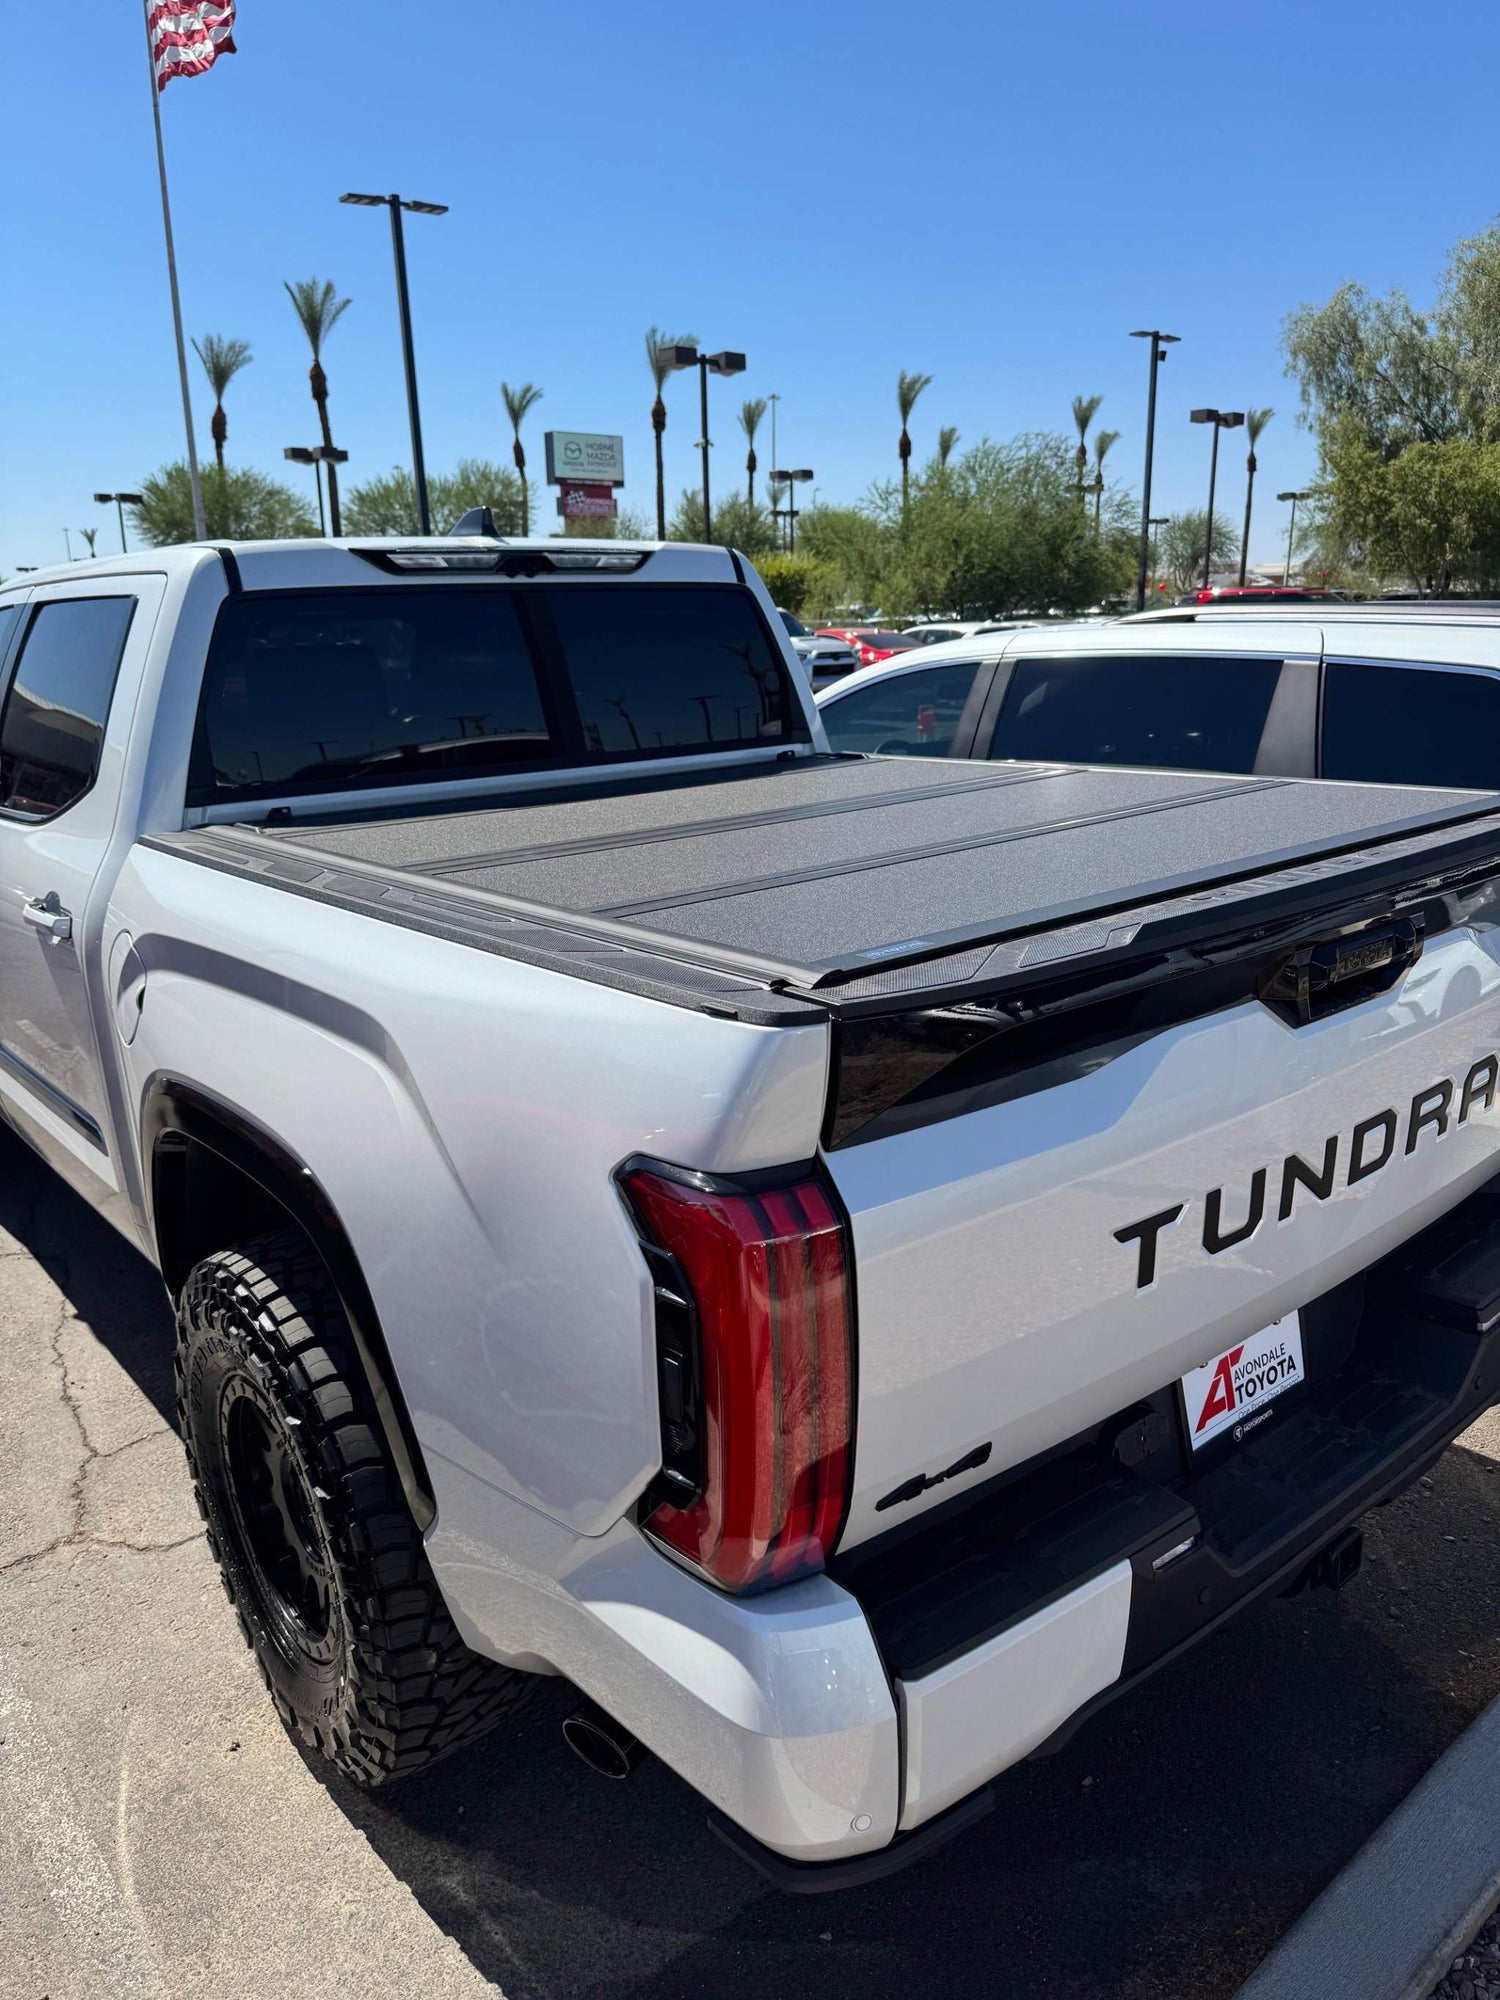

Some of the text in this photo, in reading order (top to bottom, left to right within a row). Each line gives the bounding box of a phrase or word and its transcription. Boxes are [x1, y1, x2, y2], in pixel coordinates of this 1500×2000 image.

[1112, 1053, 1499, 1289] TUNDRA
[1234, 1342, 1287, 1384] AVONDALE
[1234, 1354, 1297, 1405] TOYOTA
[1243, 1408, 1274, 1434] MOTORSPORTS
